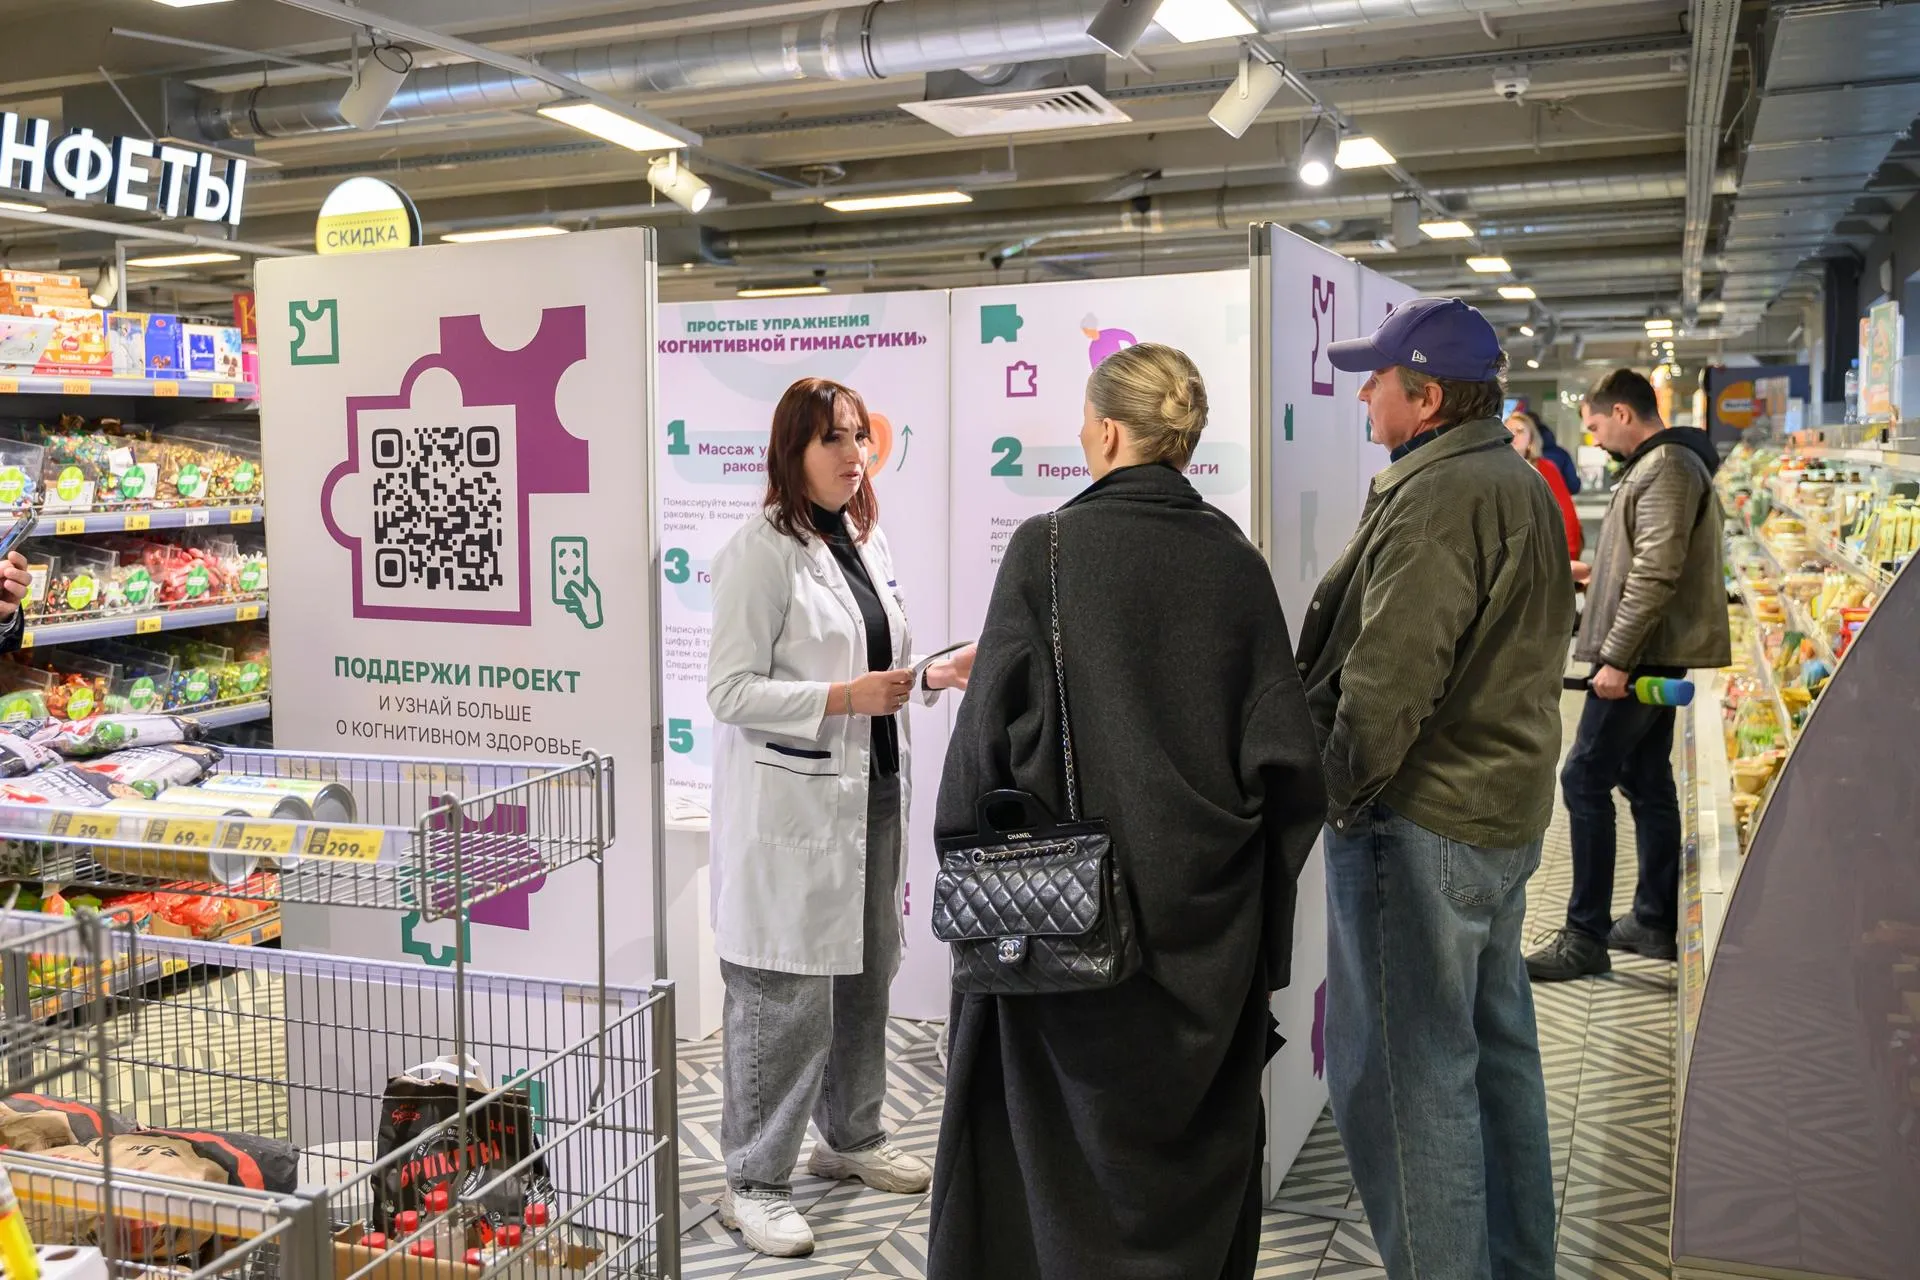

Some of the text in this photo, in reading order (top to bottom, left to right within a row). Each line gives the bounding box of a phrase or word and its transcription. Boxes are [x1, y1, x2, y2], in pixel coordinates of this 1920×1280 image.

[0, 112, 247, 226] НФЕТЫ
[326, 224, 400, 248] СКИДКА
[687, 314, 870, 333] ПРОСТЫЕ УПРАЖНЕНИЯ
[658, 331, 927, 354] КОГНИТИВНОЙ ГИМНАСТИКИ»
[667, 419, 690, 455] 1
[698, 443, 755, 456] Массаж
[990, 436, 1023, 477] 2
[1184, 463, 1219, 476] аги
[662, 497, 757, 509] Помассируйте мочки
[664, 547, 691, 584] 3
[334, 656, 581, 694] ПОДДЕРЖИ ПРОЕКТ
[378, 695, 532, 723] И УЗНАЙ БОЛЬШЕ
[336, 719, 582, 757] О КОГНИТИВНОМ ЗДОРОВЬЕ
[668, 718, 694, 754] 5
[1008, 832, 1032, 840] CHANEL
